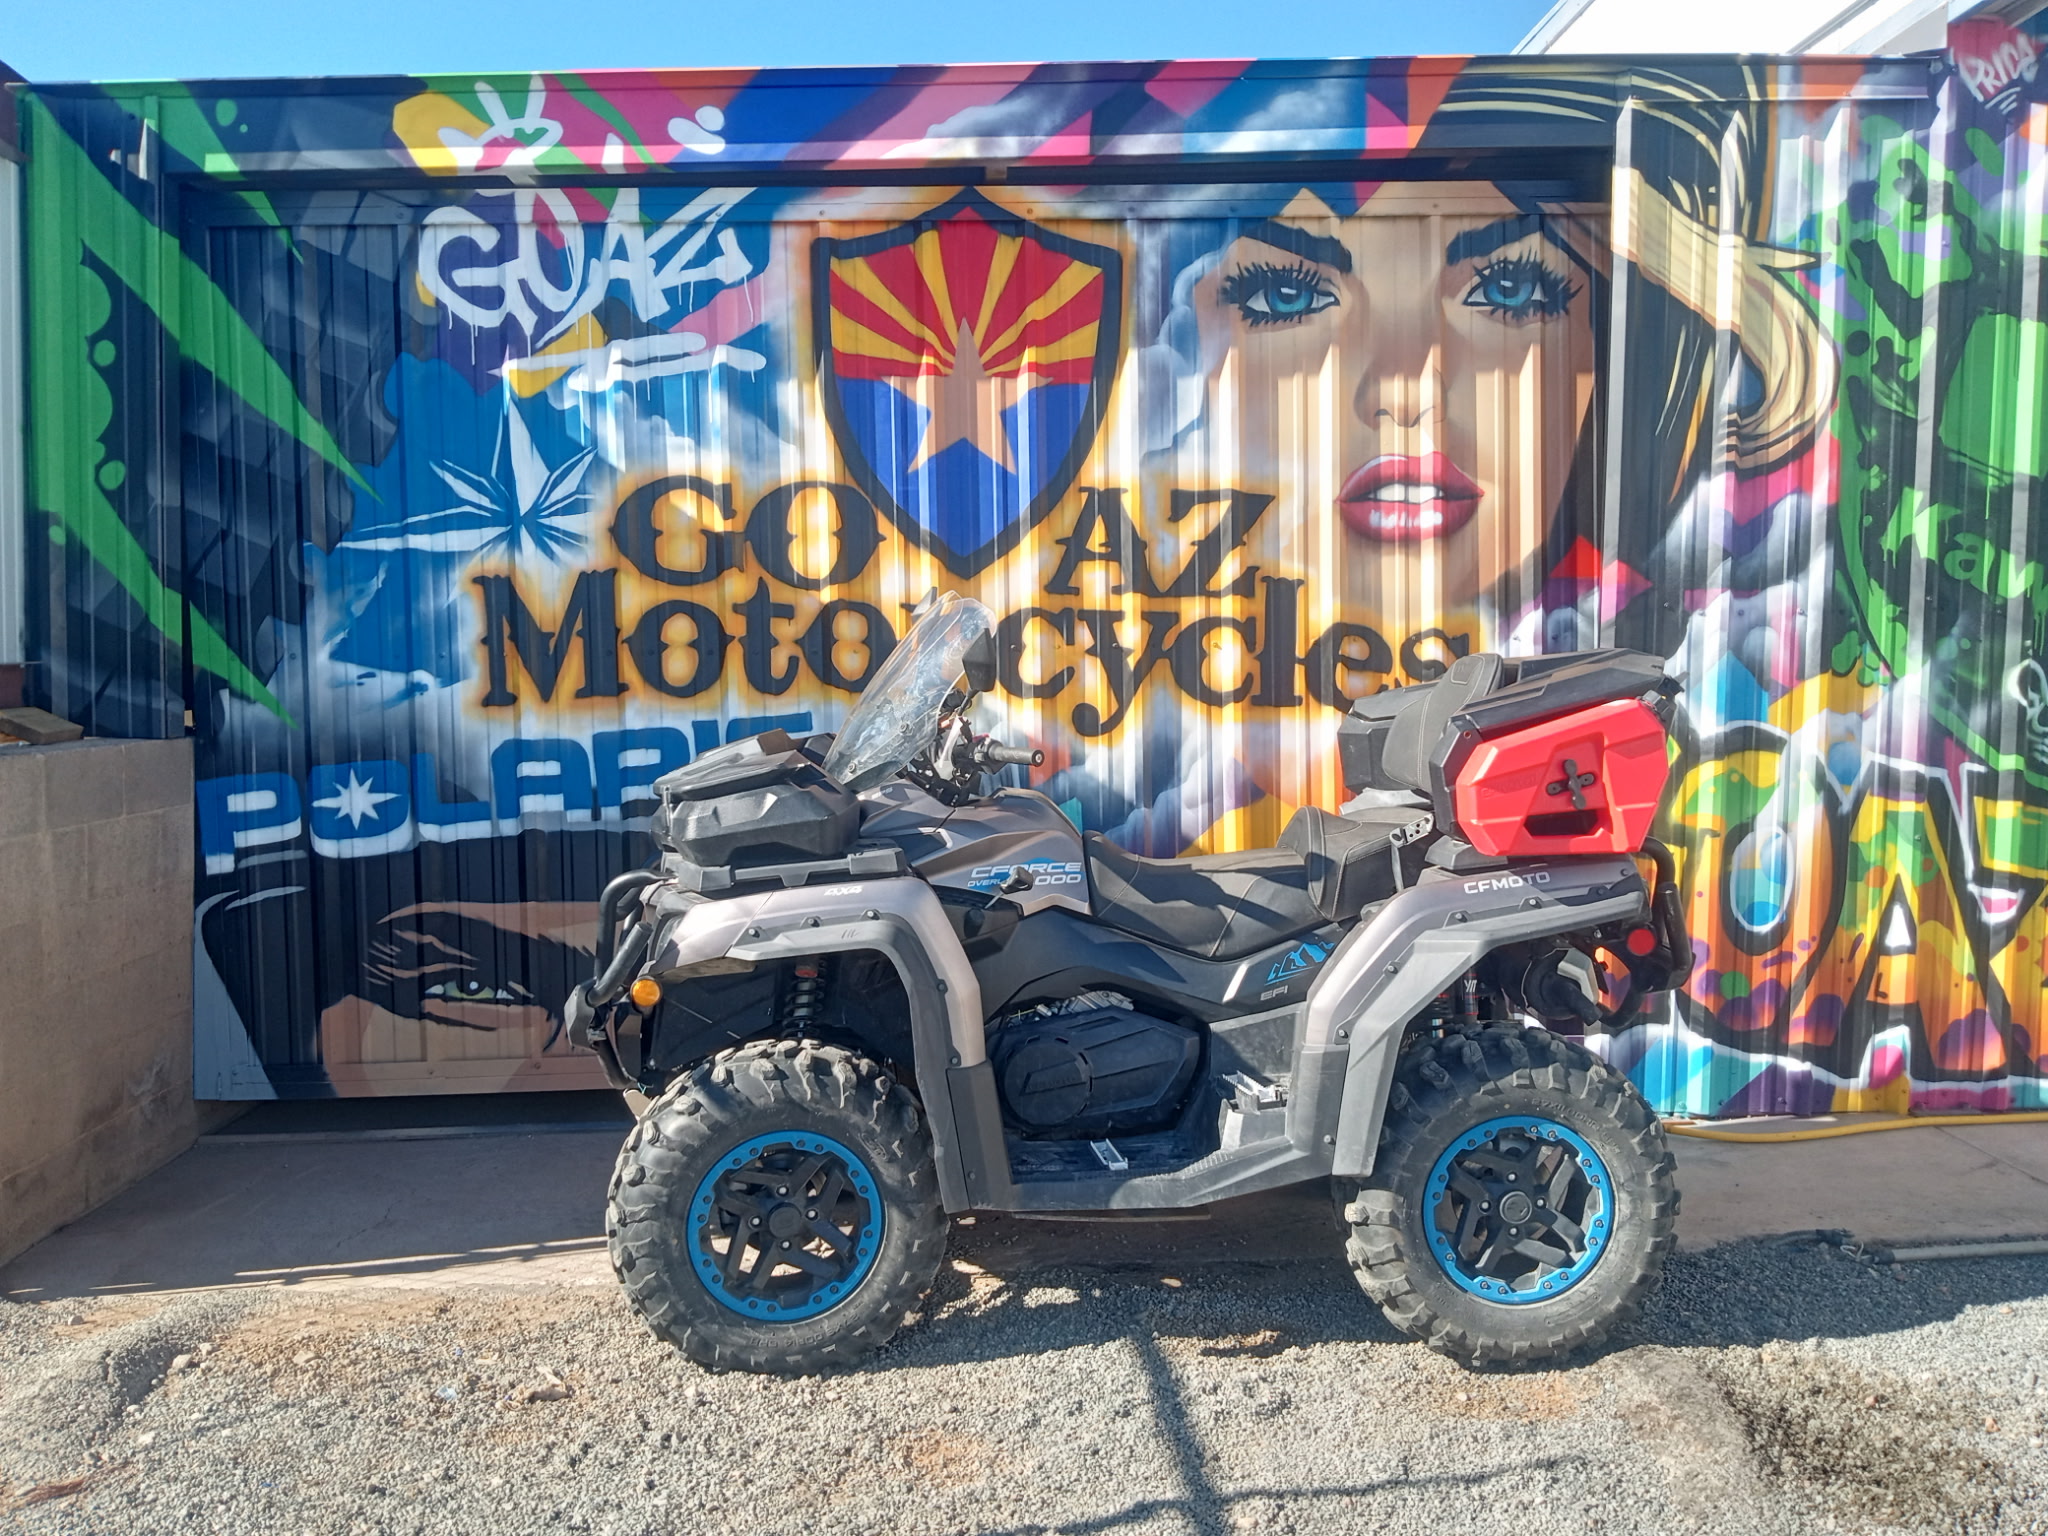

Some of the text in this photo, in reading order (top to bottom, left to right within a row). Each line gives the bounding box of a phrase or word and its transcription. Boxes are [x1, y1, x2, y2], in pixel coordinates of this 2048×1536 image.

[608, 475, 1276, 598] GO AZ
[1463, 872, 1550, 894] CFMOTO
[1260, 985, 1289, 1001] EFI
